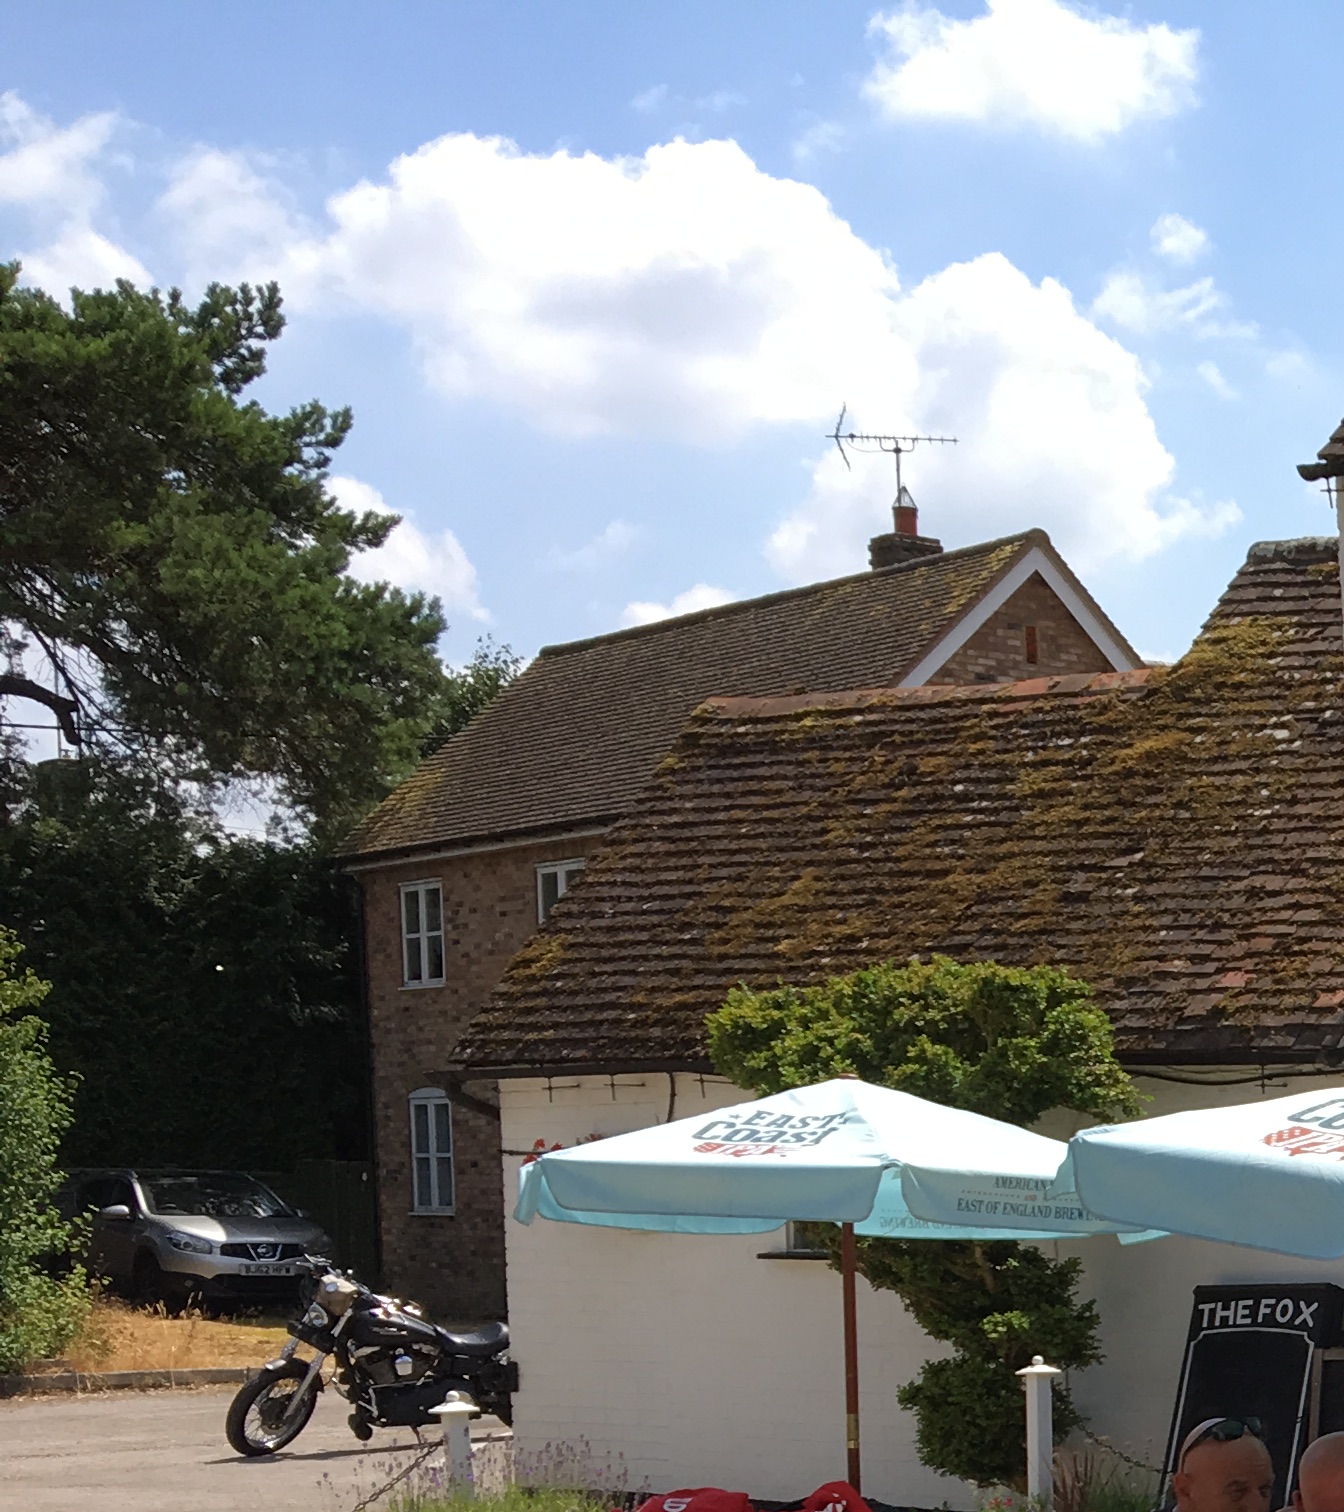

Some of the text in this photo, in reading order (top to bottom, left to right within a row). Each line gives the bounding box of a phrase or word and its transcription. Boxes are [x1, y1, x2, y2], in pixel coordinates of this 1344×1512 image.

[740, 1110, 846, 1129] EAST
[994, 1176, 1047, 1191] AMERICAN
[957, 1198, 1103, 1222] EAST OF ENGLAND BREW
[1198, 1298, 1319, 1328] THE FOX
